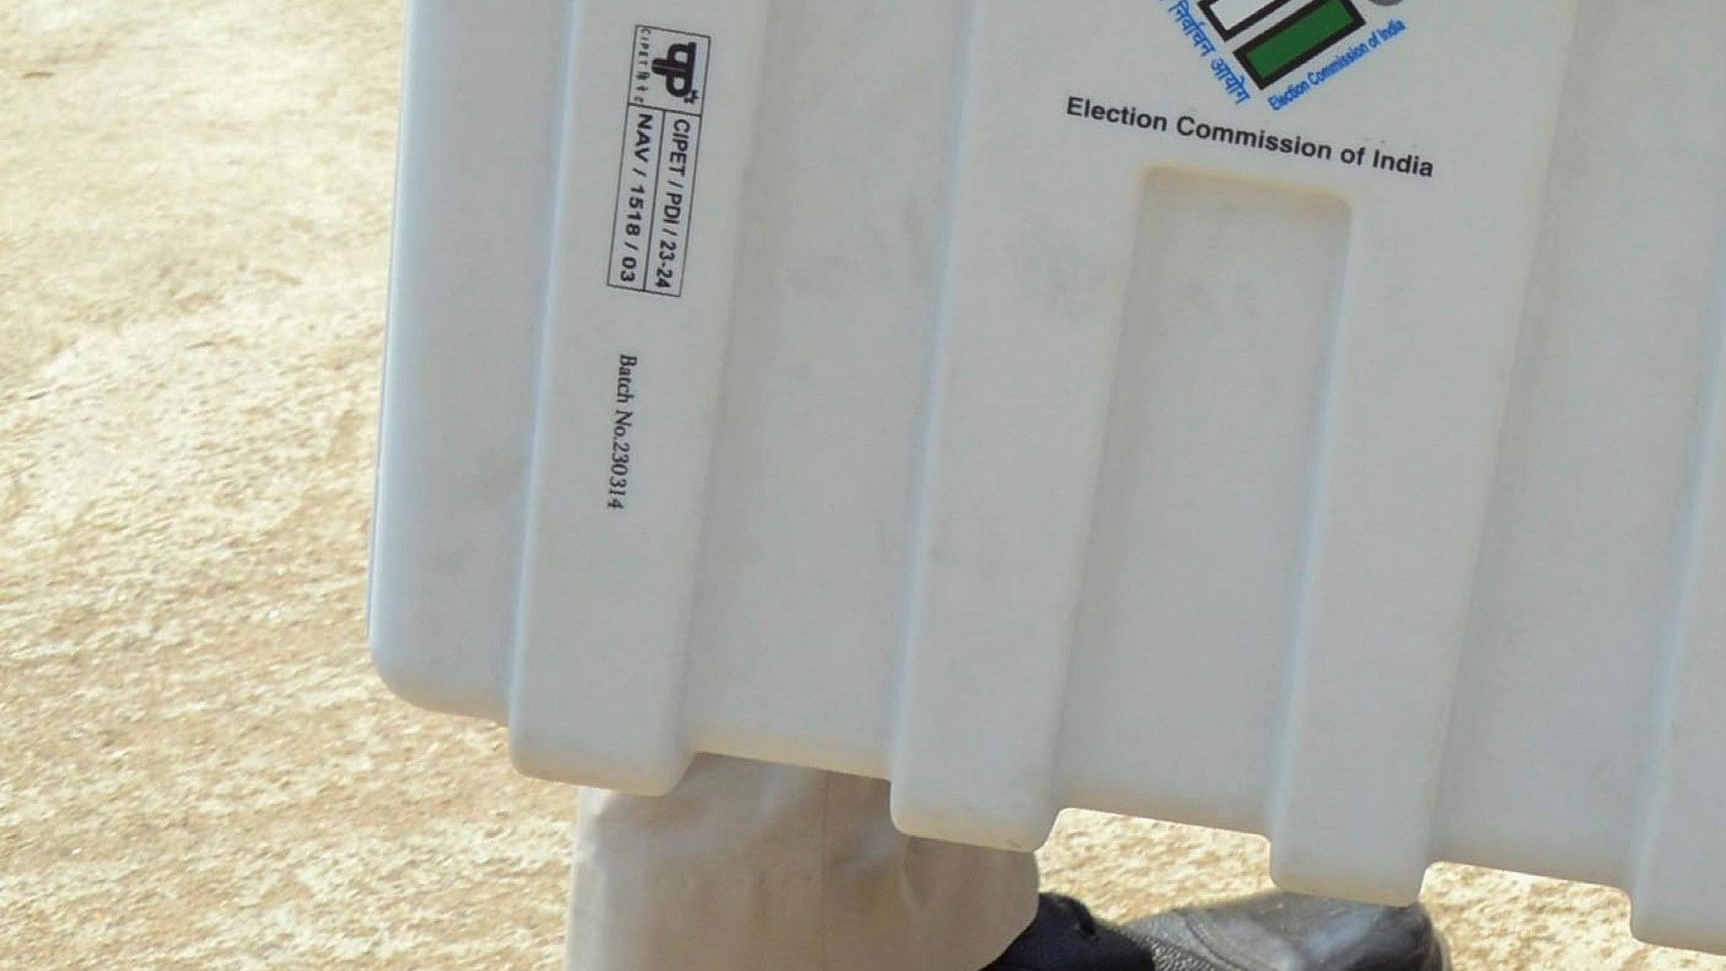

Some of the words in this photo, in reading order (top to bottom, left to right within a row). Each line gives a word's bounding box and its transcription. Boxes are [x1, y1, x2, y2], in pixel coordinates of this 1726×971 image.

[1168, 0, 1216, 57] निर्वाचन
[1210, 57, 1250, 106] आयोग
[1268, 80, 1309, 110] Election
[1307, 44, 1368, 87] Commission
[1366, 31, 1380, 50] of
[1376, 18, 1406, 45] India
[634, 114, 653, 162] NAV
[669, 120, 690, 177] CIPET
[1066, 95, 1168, 132] Election
[1177, 115, 1332, 161] Commission
[1340, 145, 1365, 167] of
[1373, 149, 1434, 178] India
[625, 185, 644, 236] 1518
[664, 192, 682, 224] PDI
[620, 257, 637, 282] 03
[655, 240, 676, 288] 23-24
[615, 354, 638, 403] Batch
[606, 409, 633, 510] No.230314
